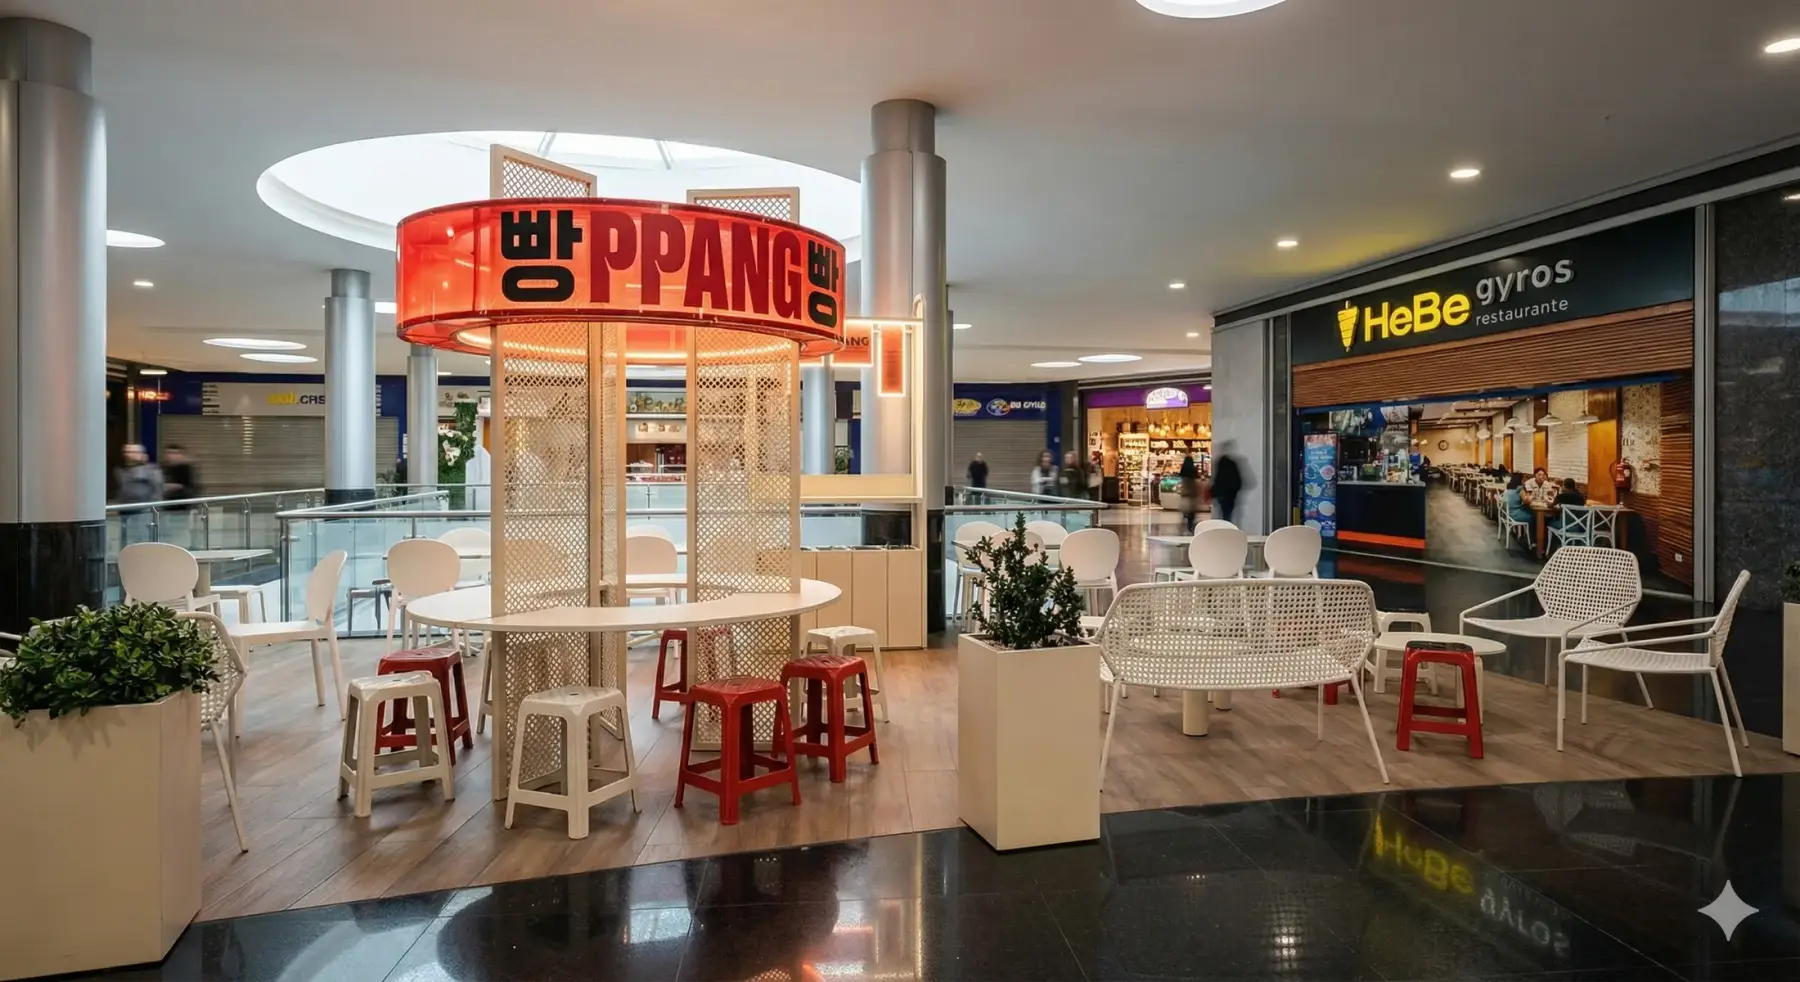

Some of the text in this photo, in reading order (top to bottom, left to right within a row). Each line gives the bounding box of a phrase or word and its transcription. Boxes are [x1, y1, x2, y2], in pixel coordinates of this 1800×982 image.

[501, 210, 582, 302] 빵
[590, 211, 802, 318] PPANG
[1476, 259, 1574, 305] gyros
[1364, 292, 1471, 342] HeBe
[1475, 297, 1569, 326] restaurante
